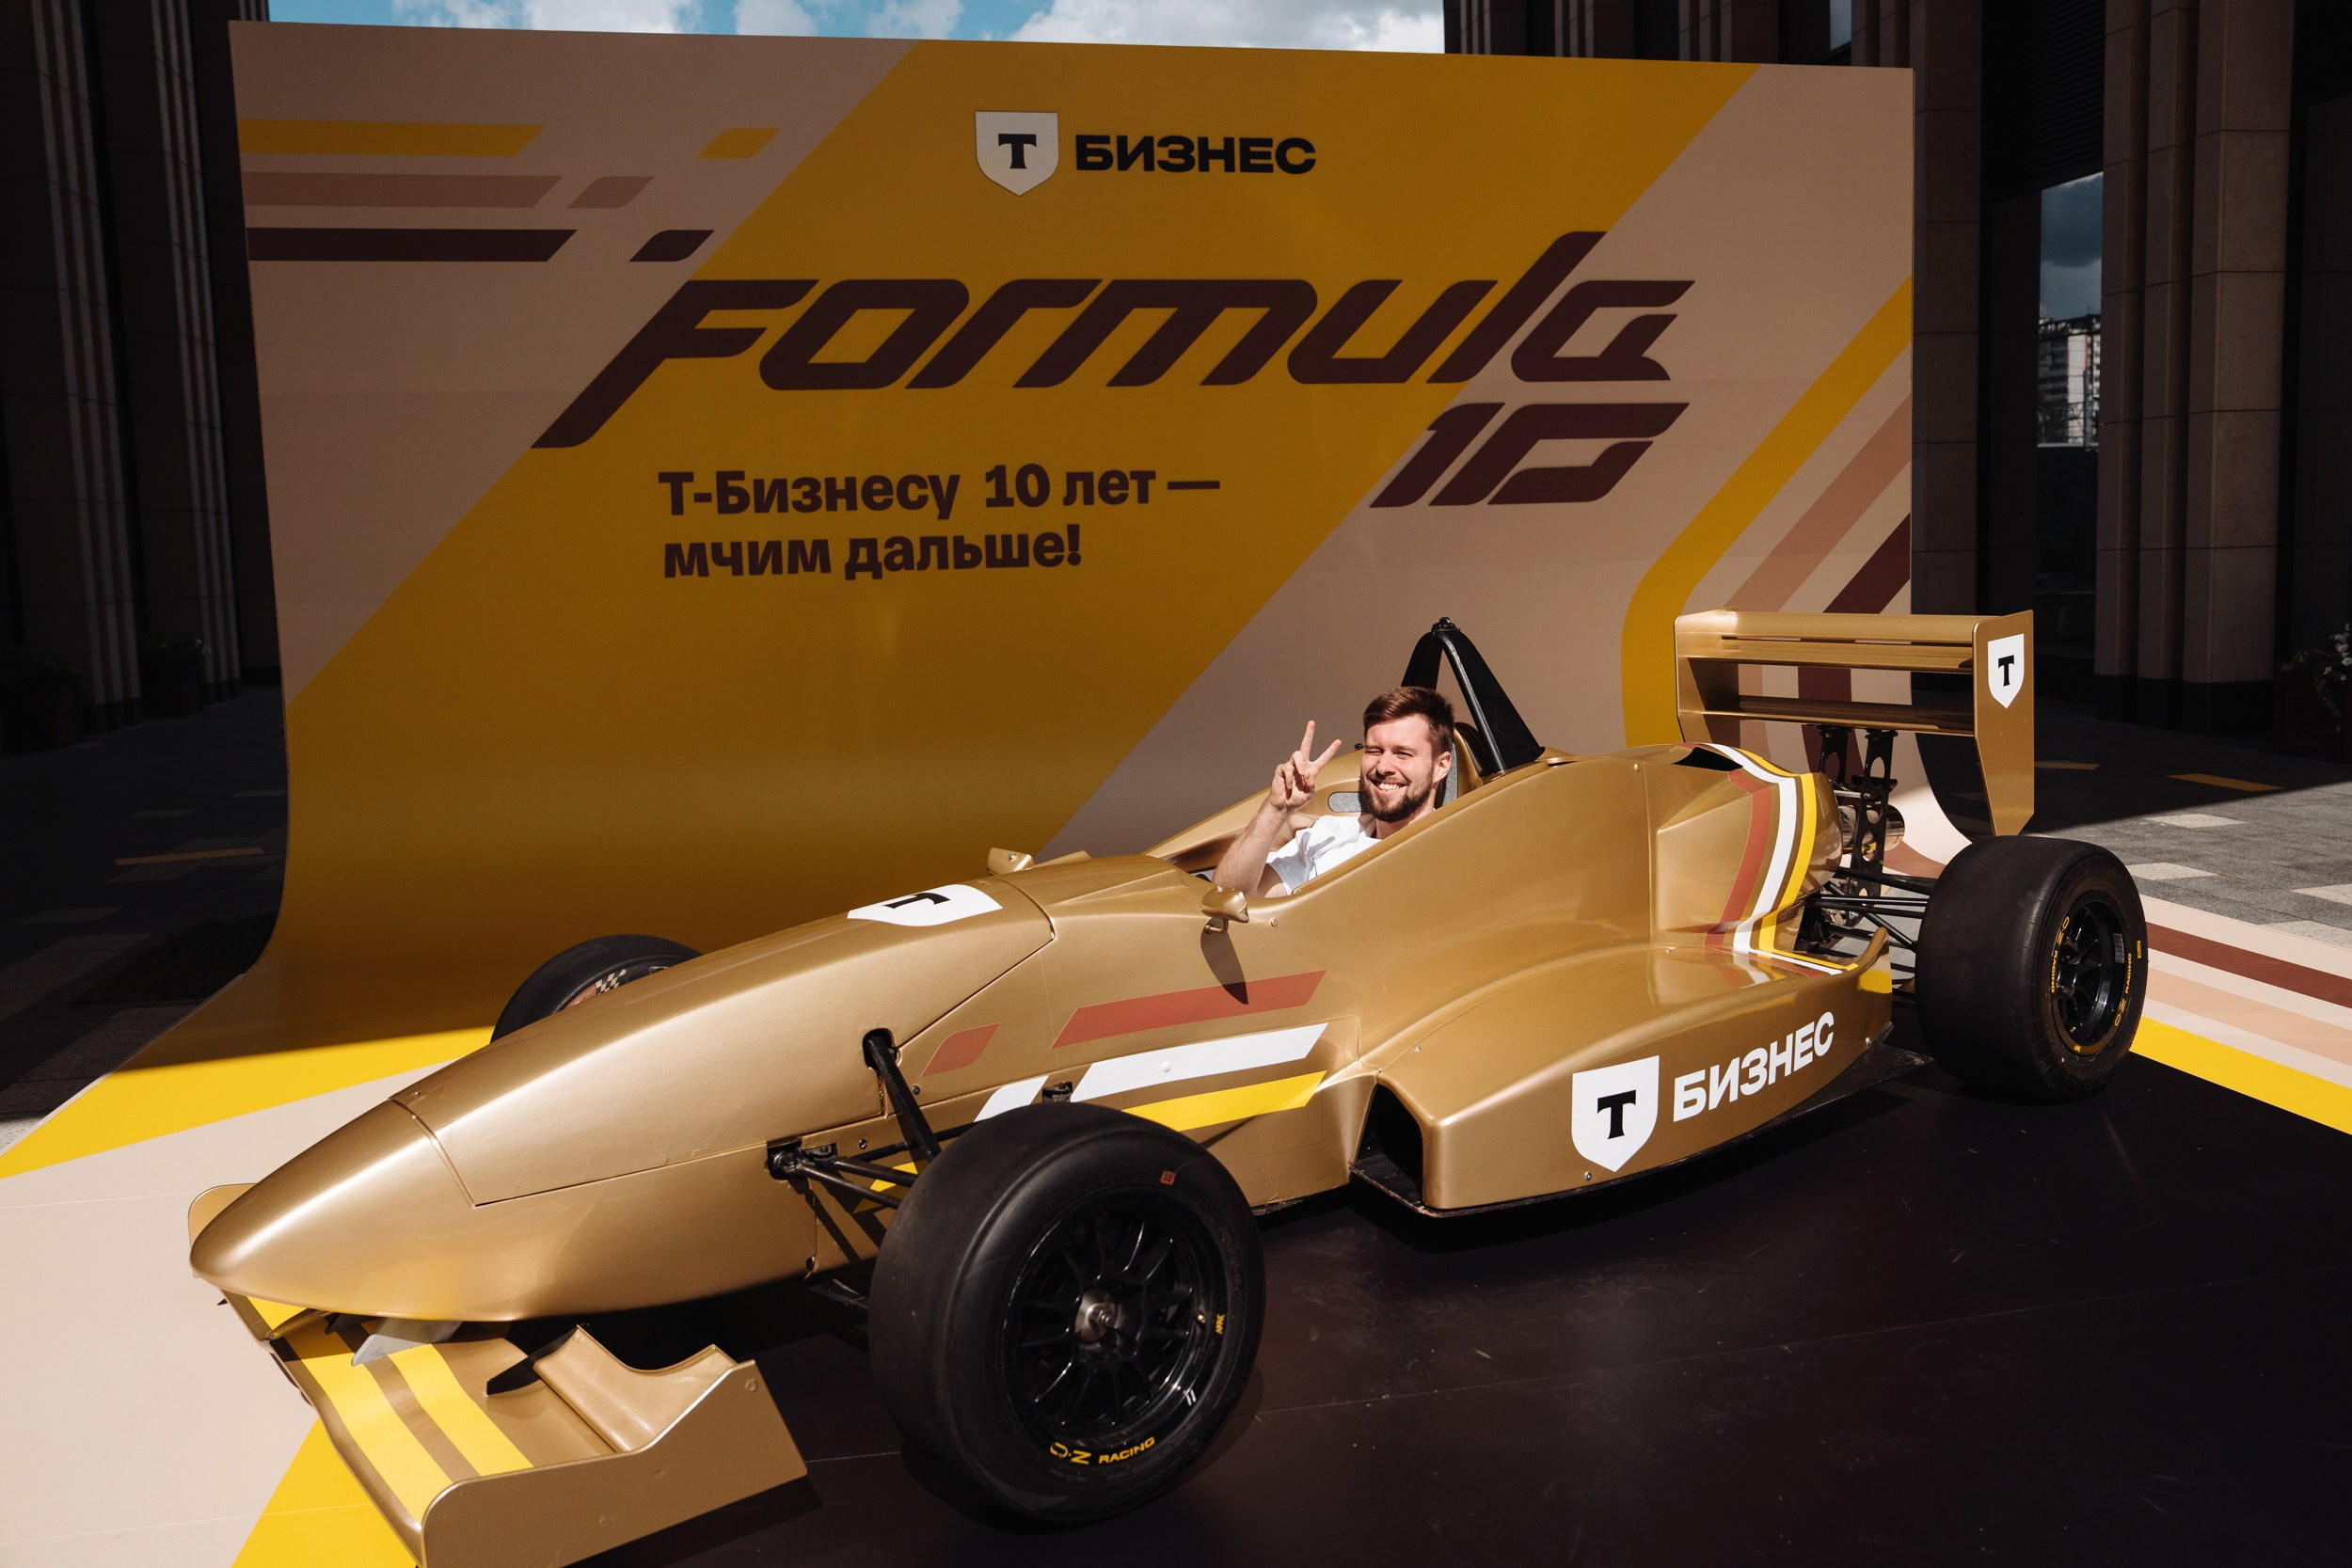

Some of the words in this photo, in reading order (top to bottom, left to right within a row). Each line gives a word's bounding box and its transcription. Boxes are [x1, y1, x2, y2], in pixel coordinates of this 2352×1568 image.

[1074, 134, 1317, 175] БИЗНЕС
[659, 469, 961, 520] Т-Бизнесу
[985, 463, 1051, 508] 10
[1062, 469, 1156, 507] лет
[664, 538, 832, 578] мчим
[845, 523, 1082, 580] дальше!
[1673, 1011, 1835, 1122] БИЗНЕС
[1098, 1436, 1156, 1465] RACING
